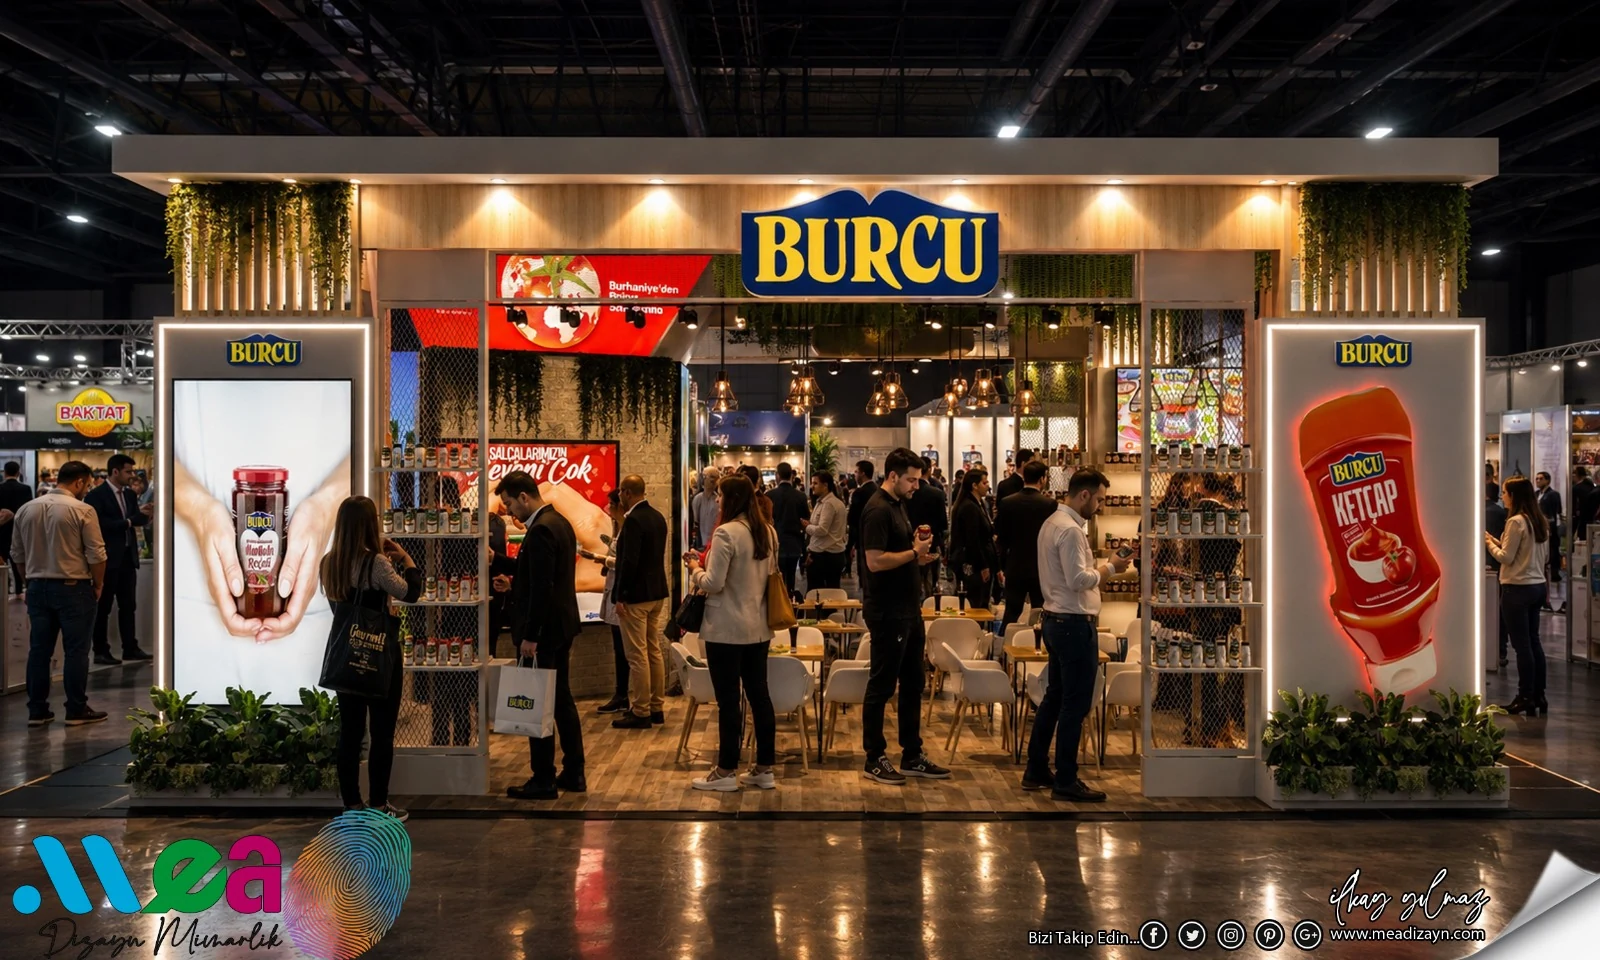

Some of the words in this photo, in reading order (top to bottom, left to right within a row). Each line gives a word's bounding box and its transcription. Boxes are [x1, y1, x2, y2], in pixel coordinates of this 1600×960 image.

[753, 214, 987, 290] BURCU
[609, 280, 679, 295] Burhaniye'den
[230, 341, 298, 367] BURCU
[1340, 342, 1409, 367] BURCU
[60, 405, 126, 420] BAKTAT
[1332, 454, 1382, 483] BURCU
[1331, 478, 1399, 527] KETÇAP
